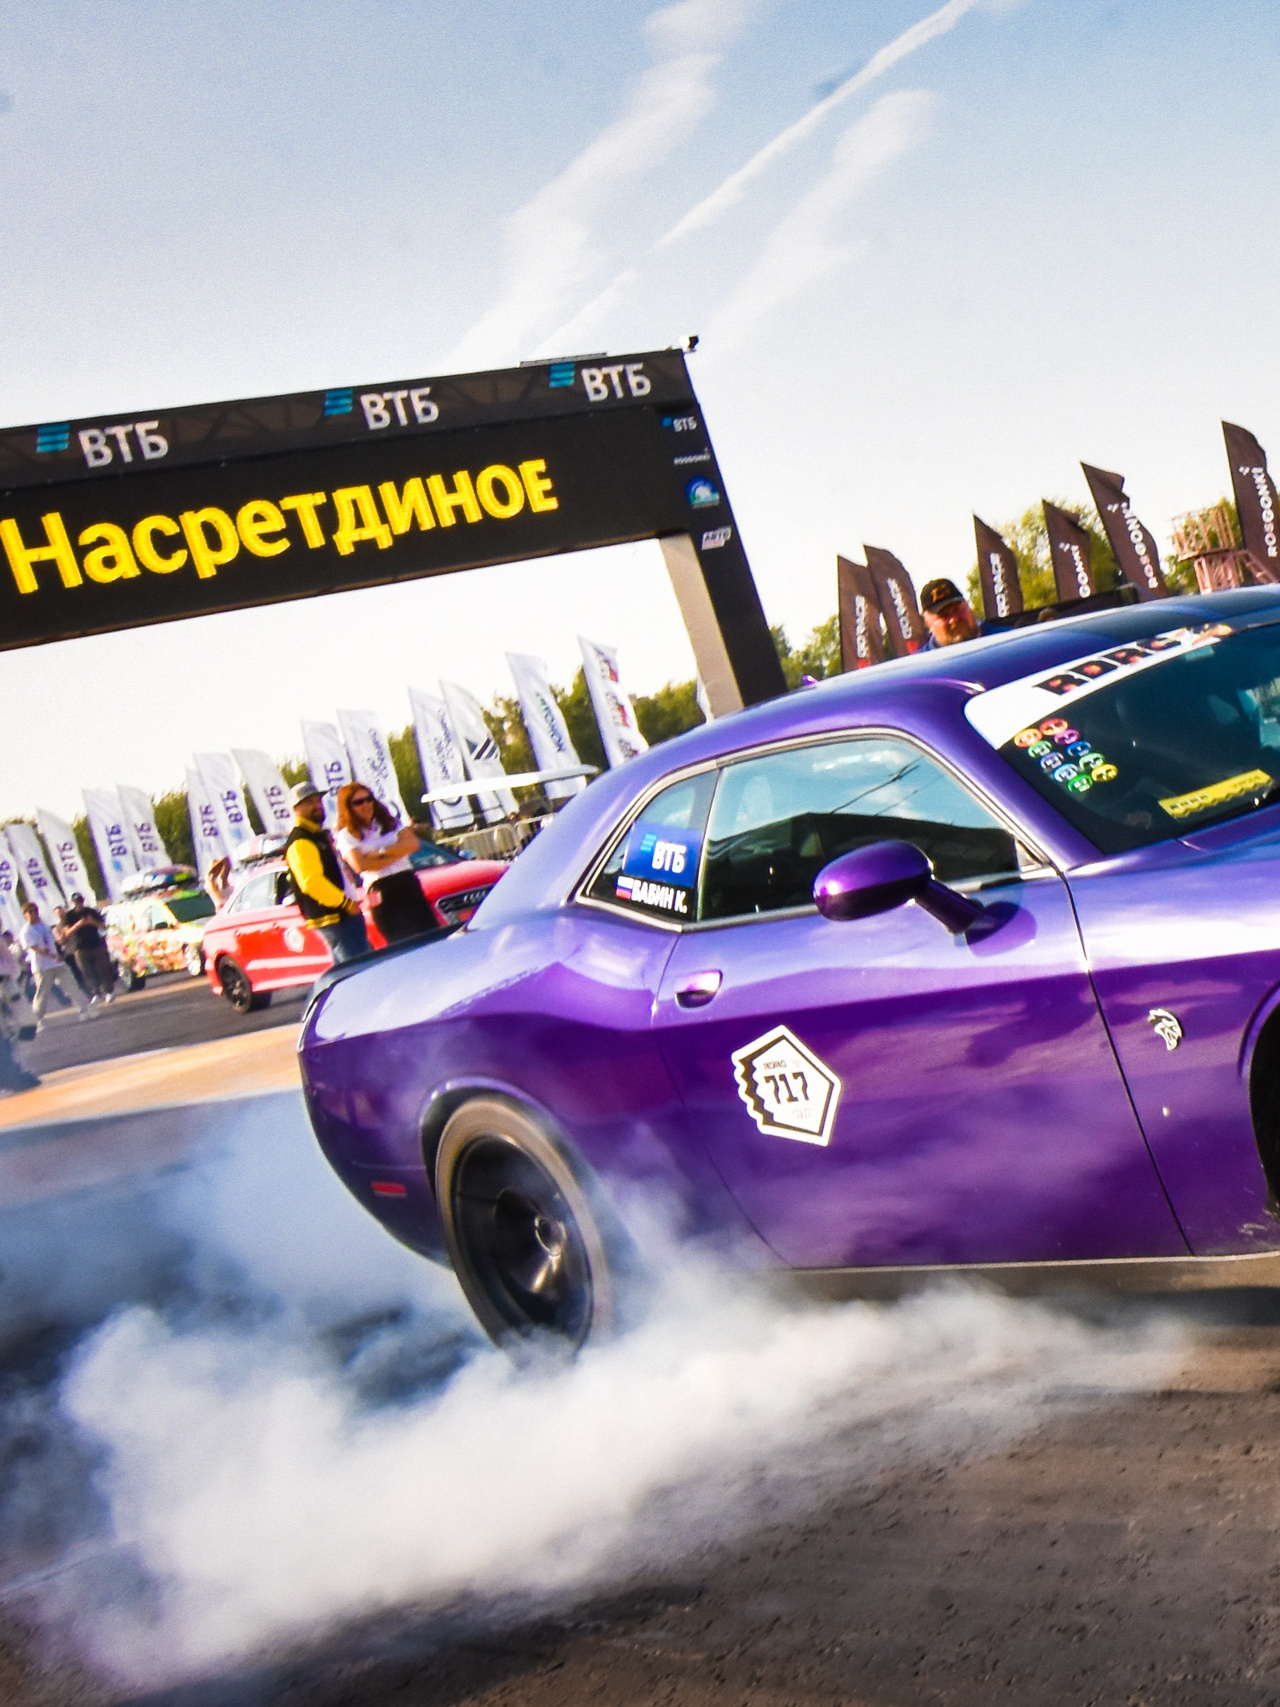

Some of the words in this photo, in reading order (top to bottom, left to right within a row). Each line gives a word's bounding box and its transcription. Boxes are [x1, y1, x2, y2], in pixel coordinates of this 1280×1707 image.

[581, 362, 652, 402] ВТБ
[360, 387, 440, 430] ВТБ
[673, 416, 698, 432] ВТБ
[77, 420, 169, 468] ВТБ
[1251, 466, 1278, 557] ROSGONKI
[221, 790, 243, 823] ВТБ
[263, 785, 290, 820] ВТБ
[134, 823, 158, 852] ВТБ
[199, 805, 219, 837] ВТБ
[57, 841, 78, 873] ВТБ
[106, 824, 127, 857] ВТБ
[651, 840, 687, 873] ВТБ
[631, 879, 674, 910] БАБИН
[764, 1071, 810, 1105] 717
